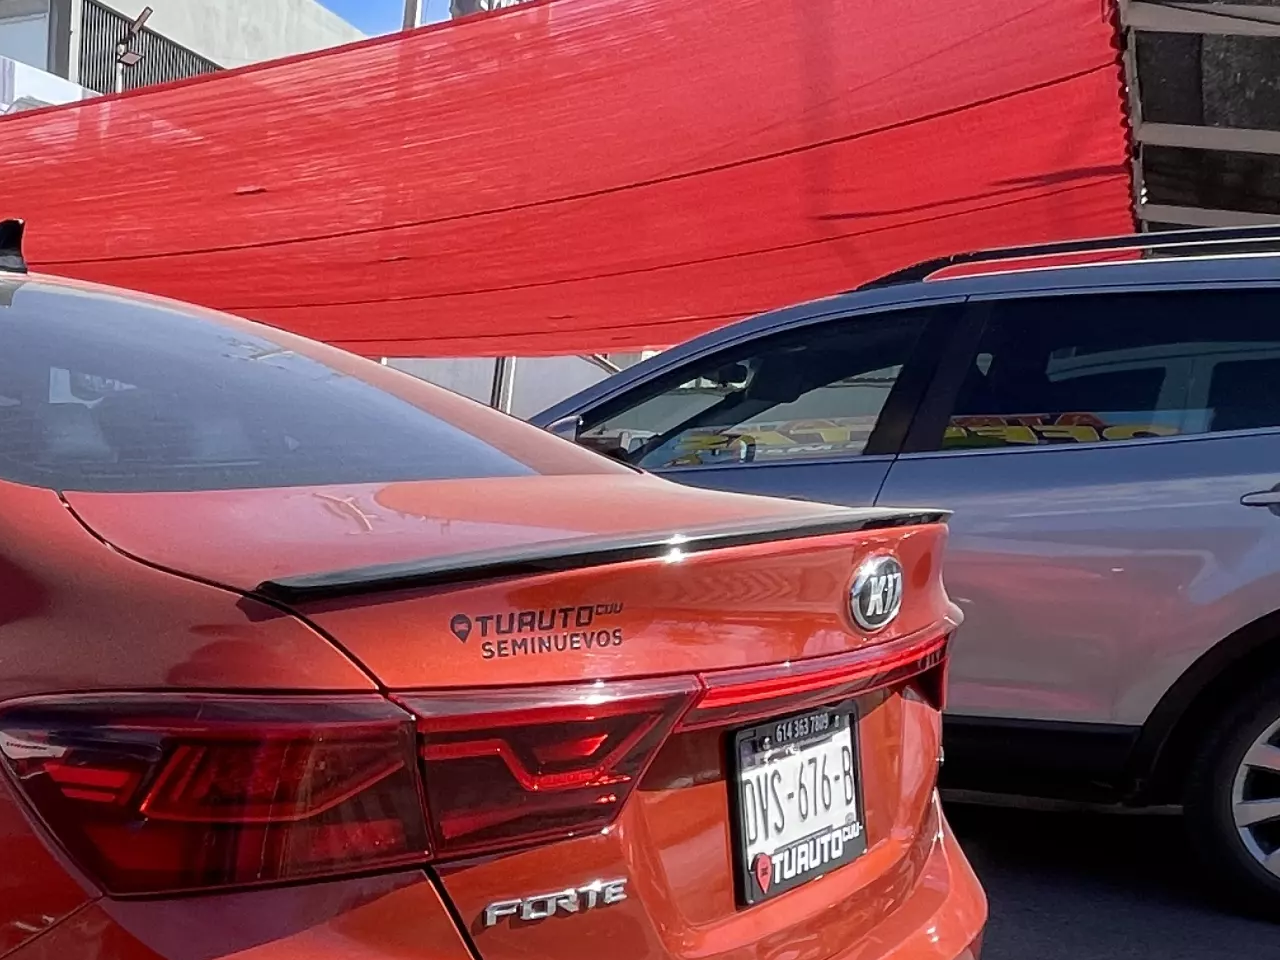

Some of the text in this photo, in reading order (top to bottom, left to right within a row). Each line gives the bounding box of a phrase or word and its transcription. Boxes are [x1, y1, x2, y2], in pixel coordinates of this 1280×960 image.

[481, 627, 623, 660] SEMINUEVOS
[776, 722, 793, 743] 614
[484, 876, 628, 927] FORTE
